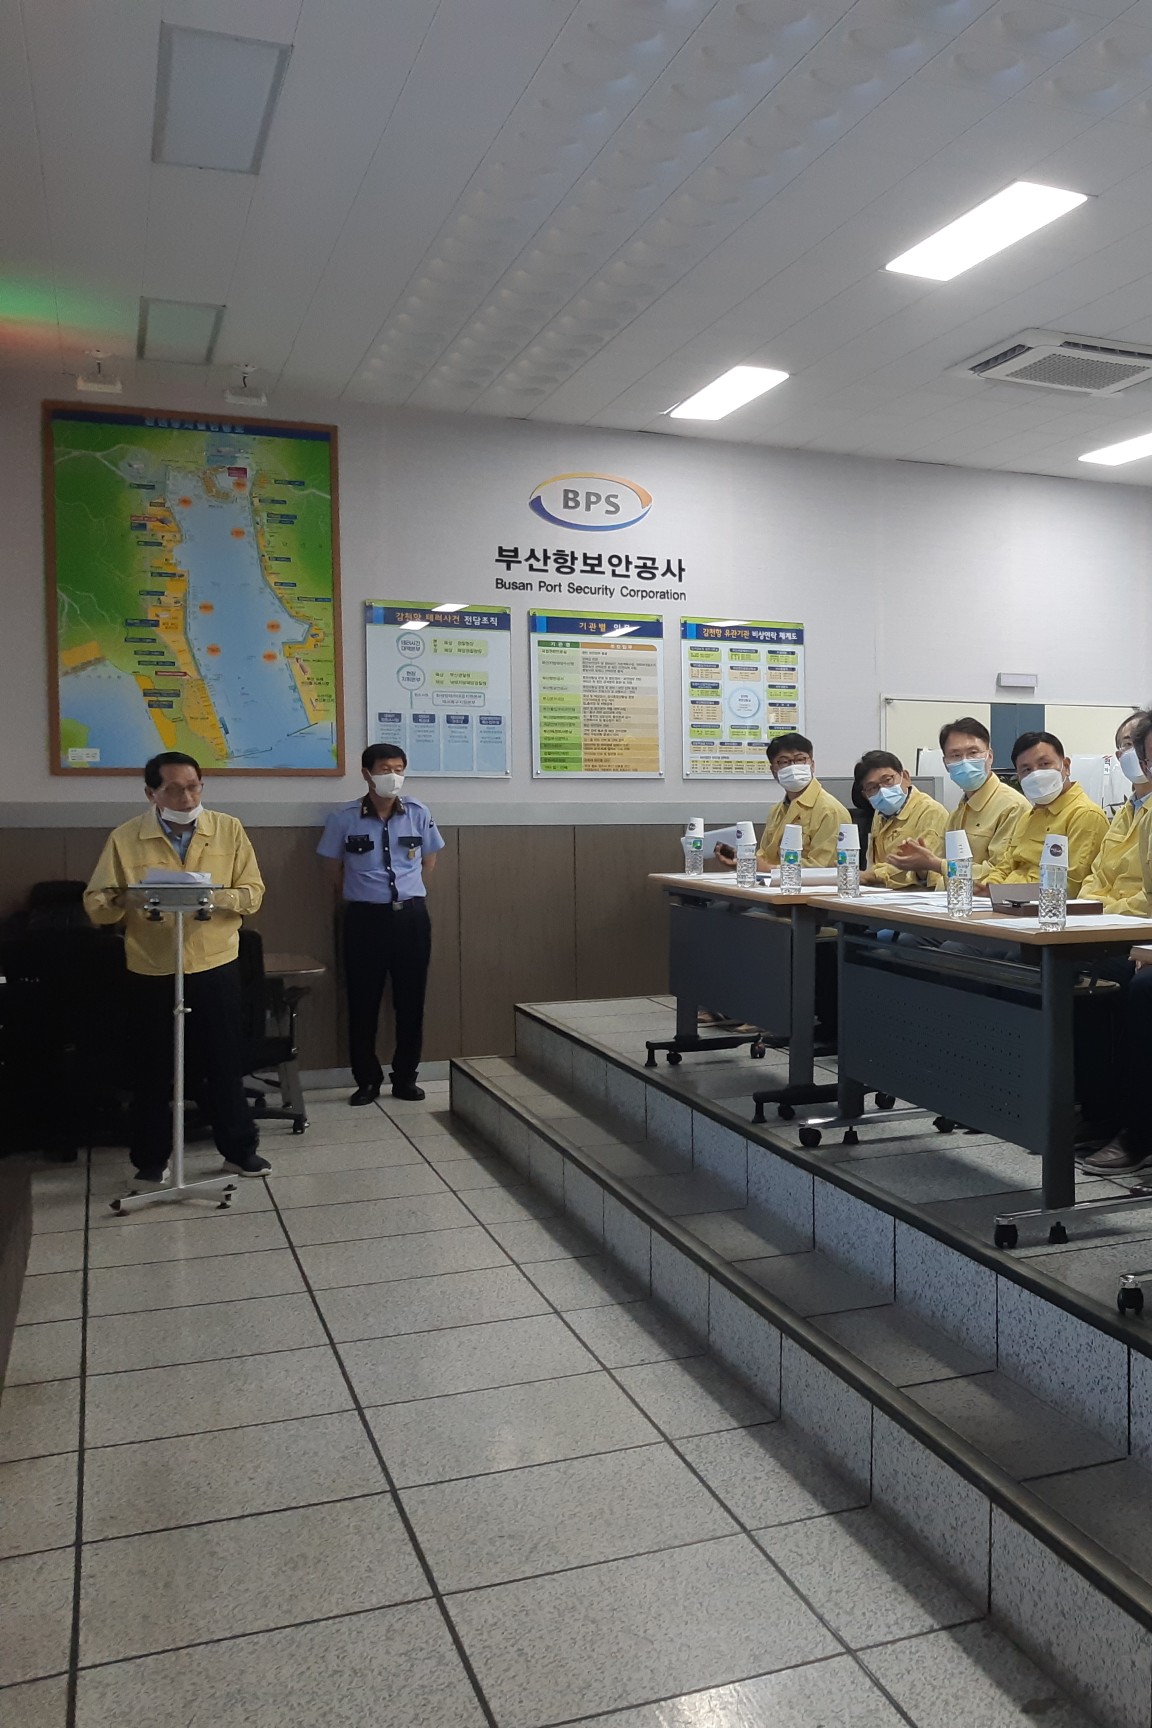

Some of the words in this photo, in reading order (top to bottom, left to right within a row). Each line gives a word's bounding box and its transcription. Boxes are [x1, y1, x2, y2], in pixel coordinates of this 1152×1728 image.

[562, 488, 621, 515] BPS
[494, 546, 687, 583] 부산항보안공사
[495, 577, 533, 592] Busan
[538, 580, 562, 593] Port
[567, 582, 615, 599] Security
[620, 586, 687, 601] Corporation
[463, 615, 498, 626] 전담조직
[702, 628, 722, 638] 감천항
